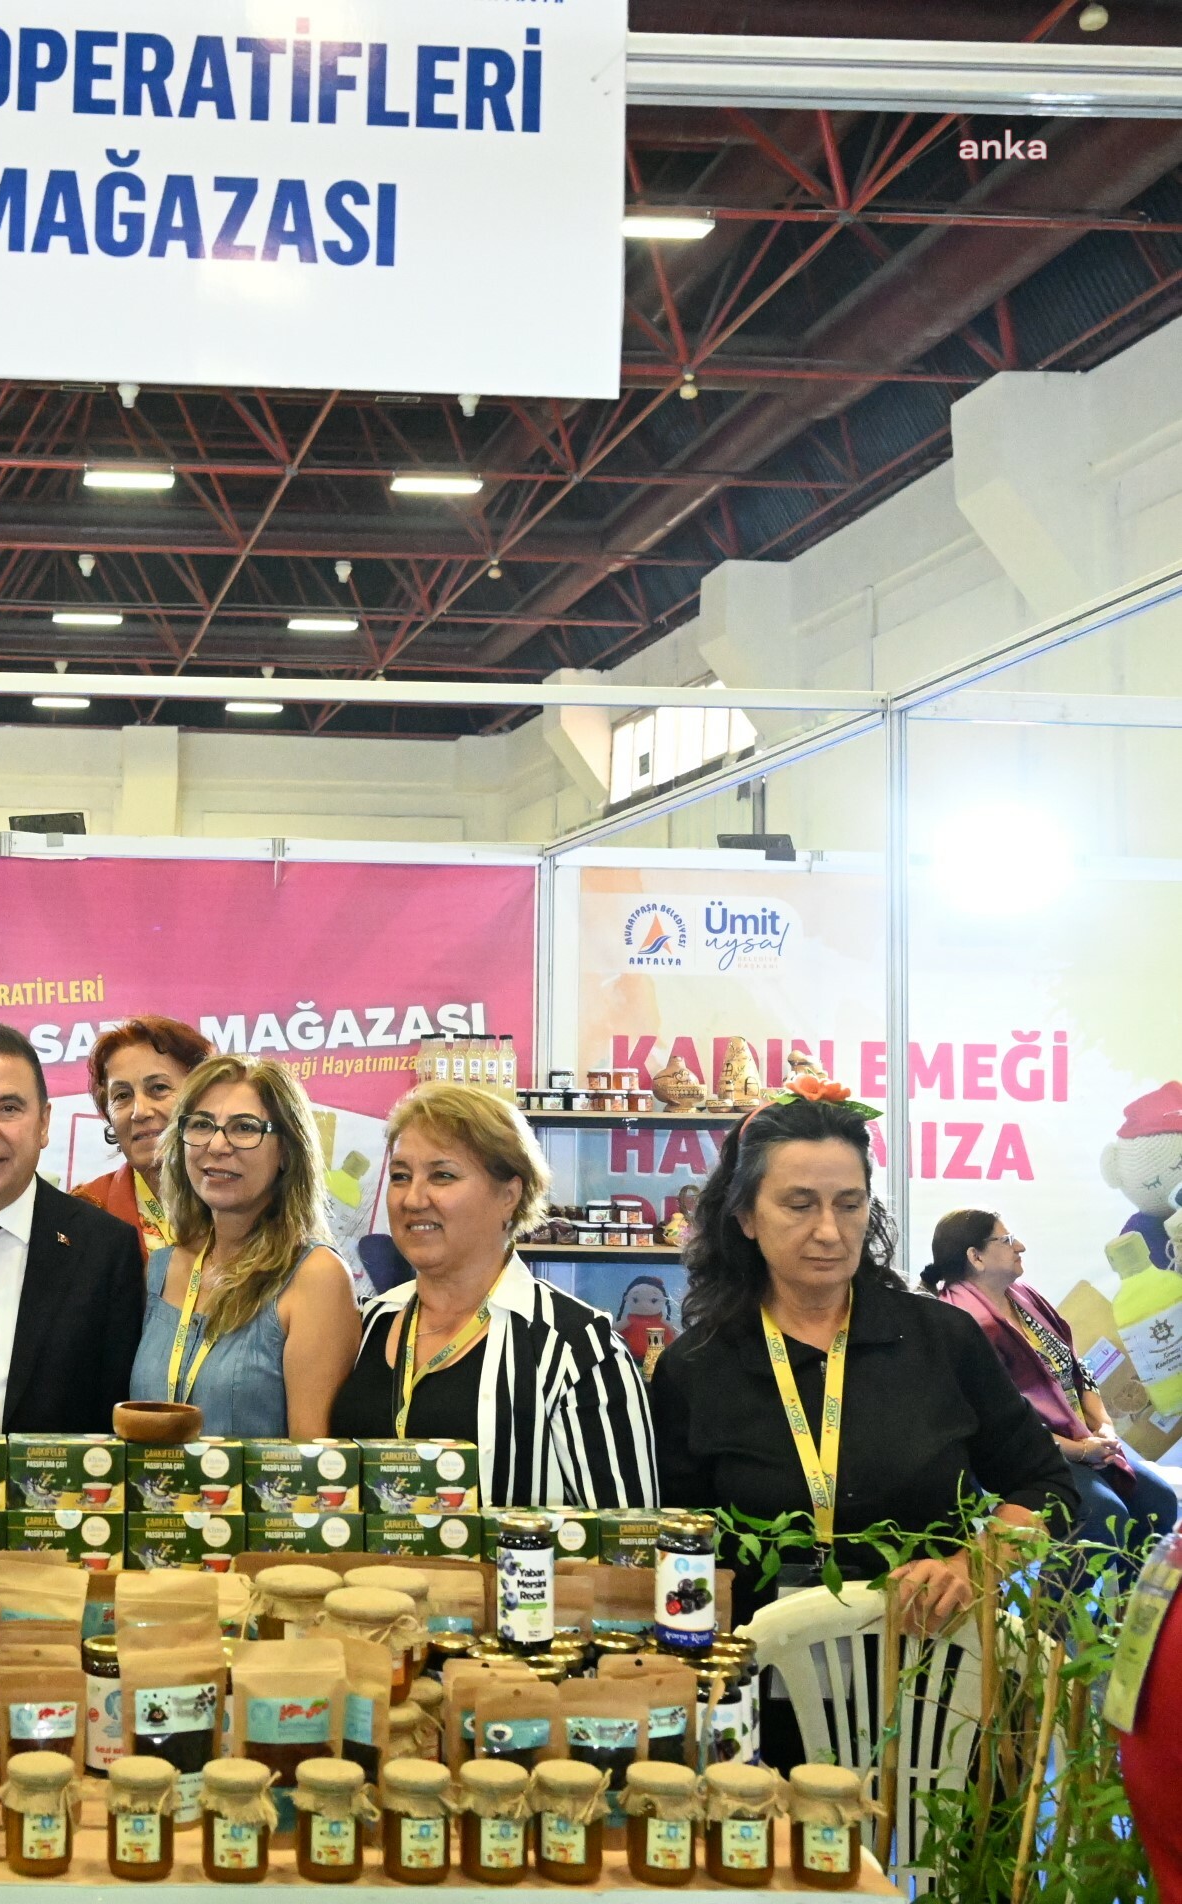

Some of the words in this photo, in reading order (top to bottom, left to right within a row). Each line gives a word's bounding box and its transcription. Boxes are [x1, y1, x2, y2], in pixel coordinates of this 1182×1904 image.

[624, 903, 658, 945] MURATPAŞA
[705, 900, 781, 936] Ümit
[629, 957, 682, 966] ANTALYA
[705, 923, 790, 971] uysal
[198, 1000, 486, 1054] MAĞAZASI
[321, 1055, 419, 1078] Hayatımıza
[859, 1029, 1069, 1103] EMEĞİ
[767, 1335, 786, 1363] YOREX
[788, 1403, 808, 1435] YOREX
[826, 1394, 838, 1429] YOREX
[811, 1475, 829, 1510] YOREX
[517, 1579, 547, 1588] Mersini
[519, 1568, 545, 1578] Yaban
[520, 1590, 545, 1602] Reçeli
